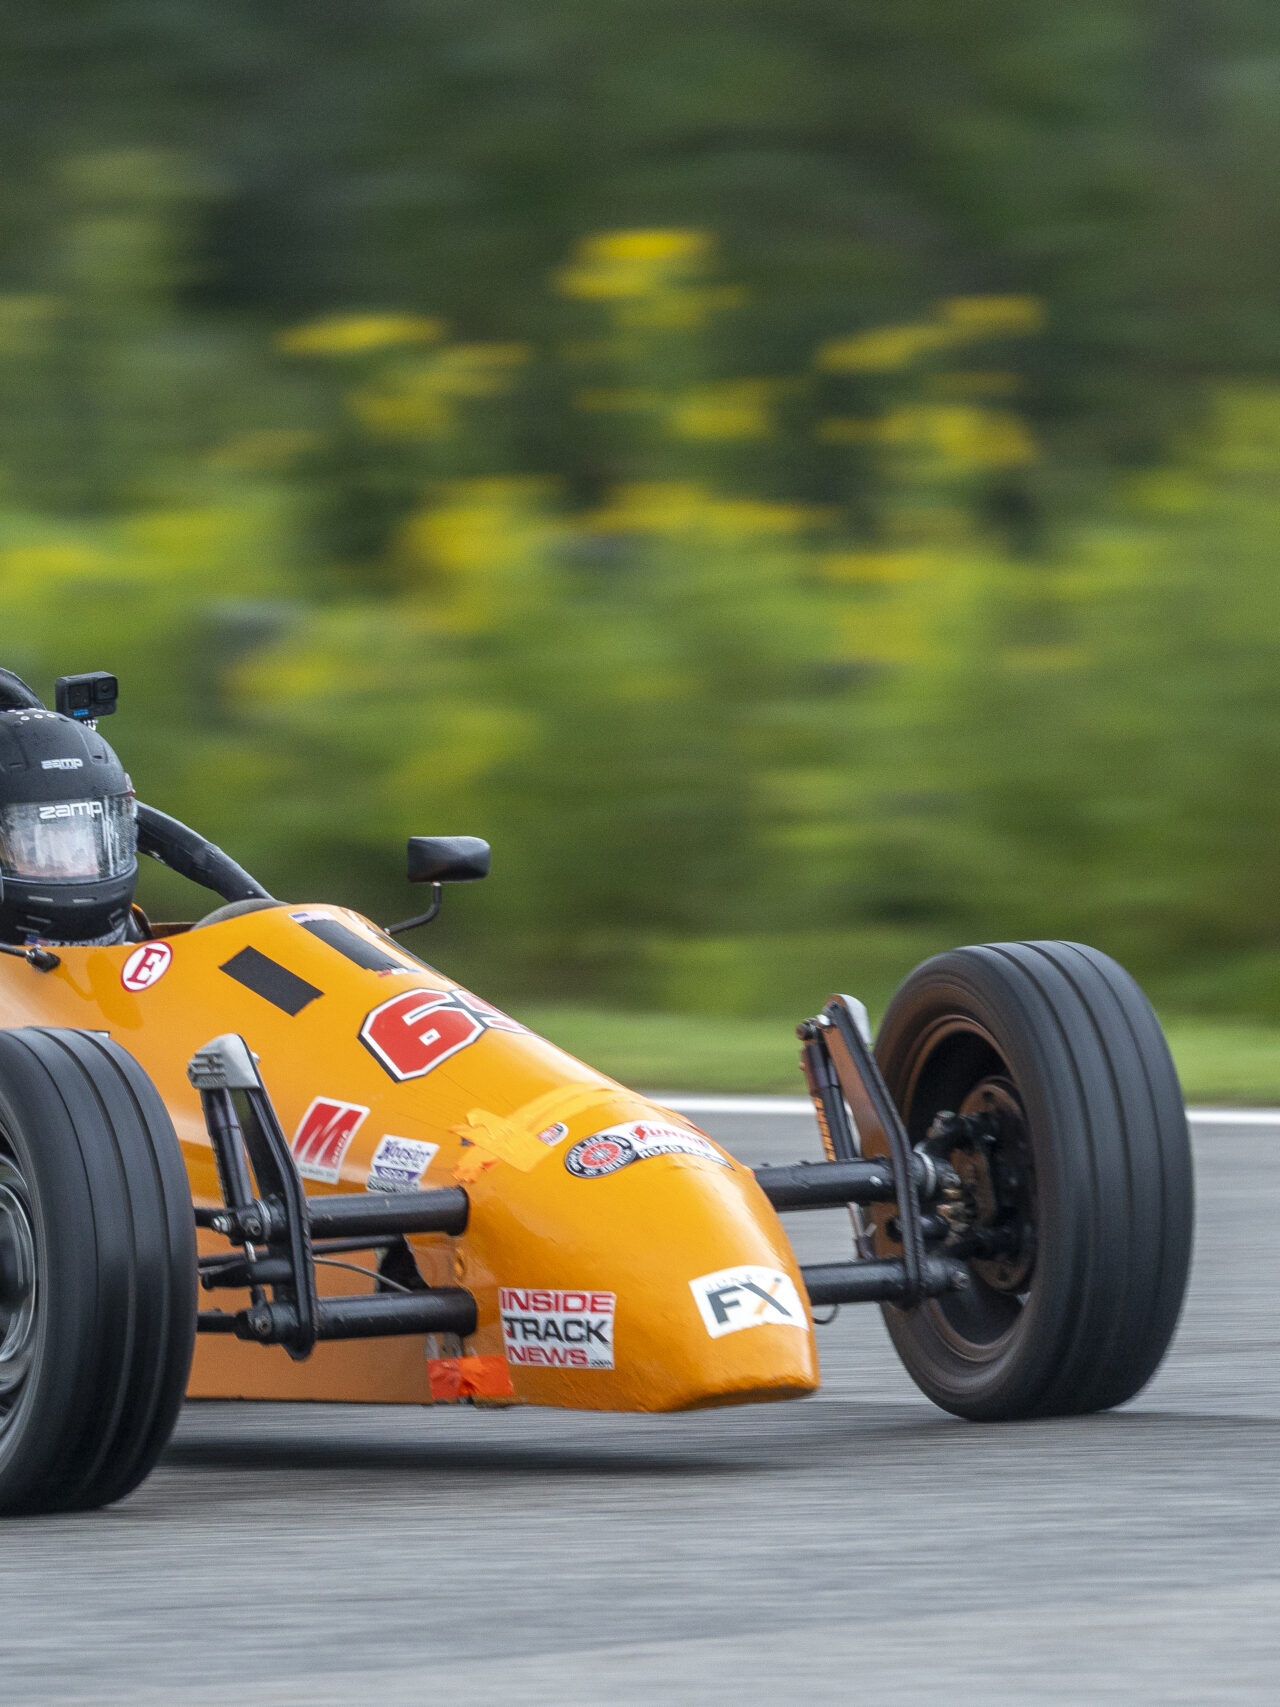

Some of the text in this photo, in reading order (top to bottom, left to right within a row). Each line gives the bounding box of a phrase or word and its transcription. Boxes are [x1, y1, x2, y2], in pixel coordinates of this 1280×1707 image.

[40, 757, 84, 770] zamp
[39, 801, 103, 820] zamp
[126, 947, 168, 985] E
[500, 1290, 613, 1313] INSIDE
[705, 1277, 793, 1325] FX
[502, 1316, 611, 1345] TRACK
